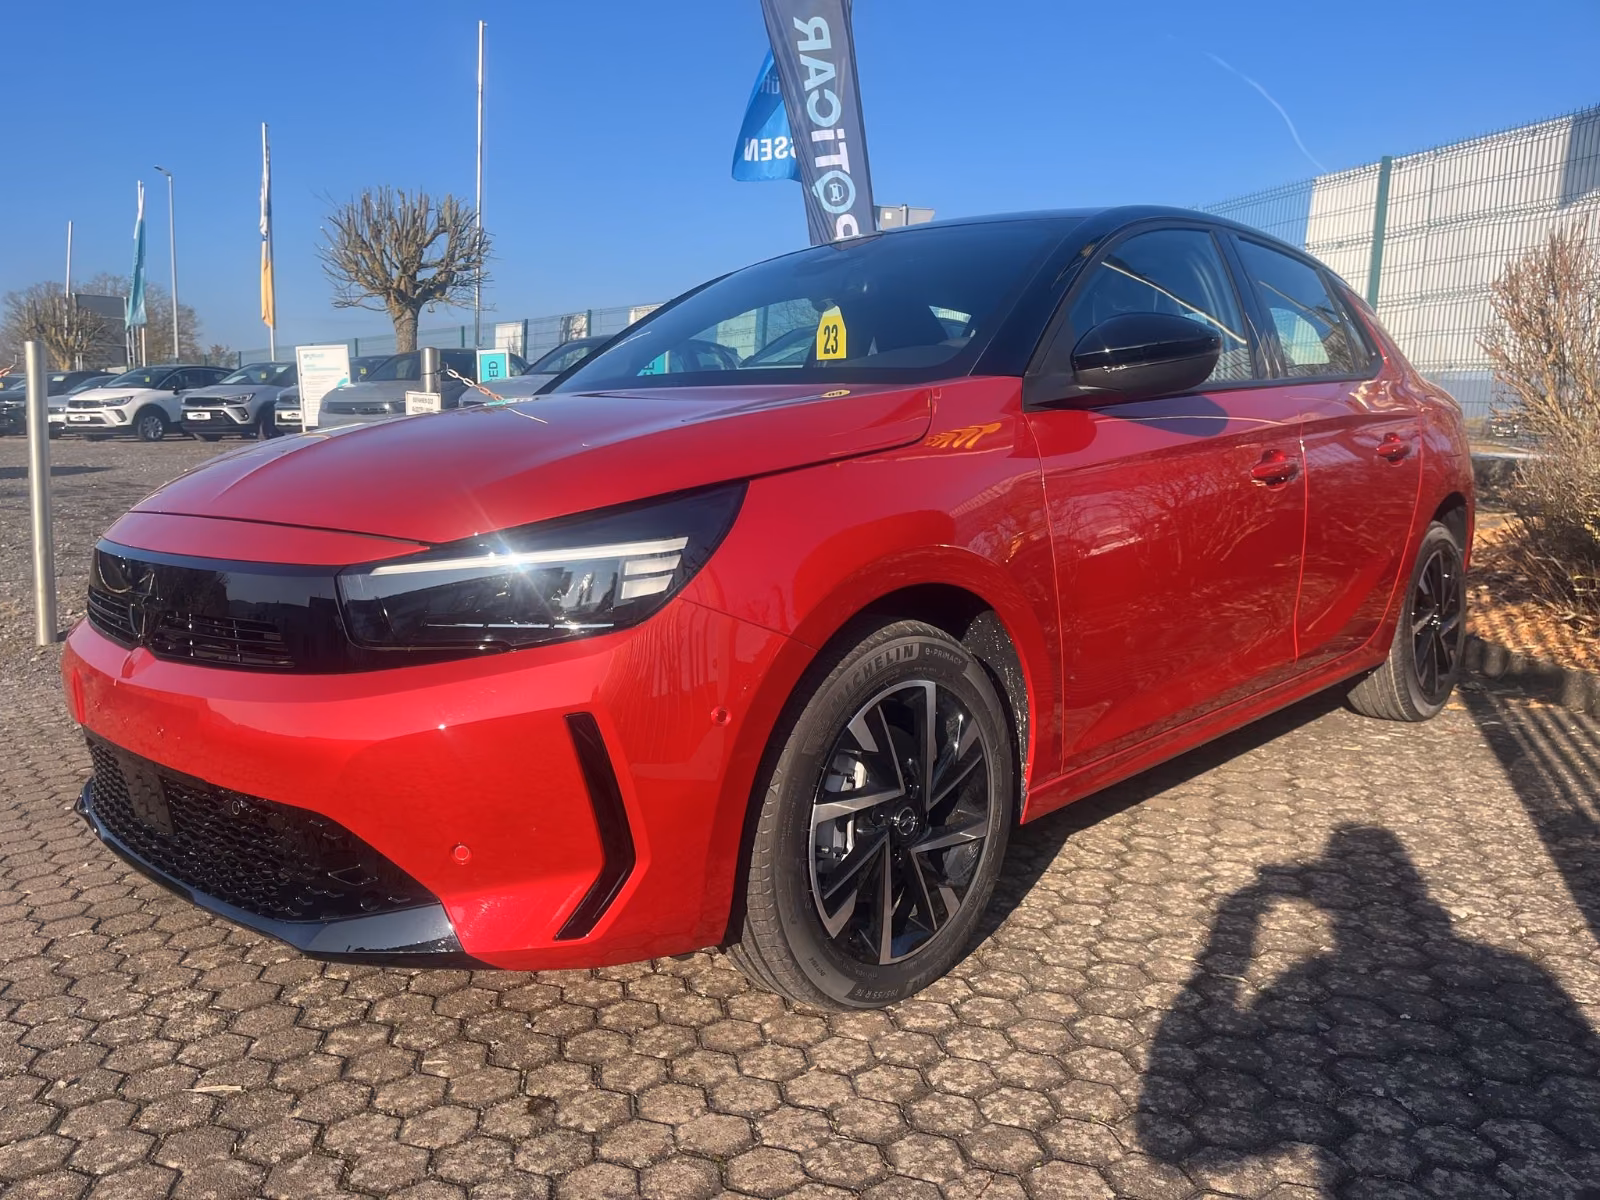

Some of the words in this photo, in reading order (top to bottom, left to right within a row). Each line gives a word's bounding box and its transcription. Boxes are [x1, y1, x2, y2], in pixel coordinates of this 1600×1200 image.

[823, 324, 838, 355] 23
[488, 361, 499, 378] ED
[830, 645, 914, 711] MICHELIN
